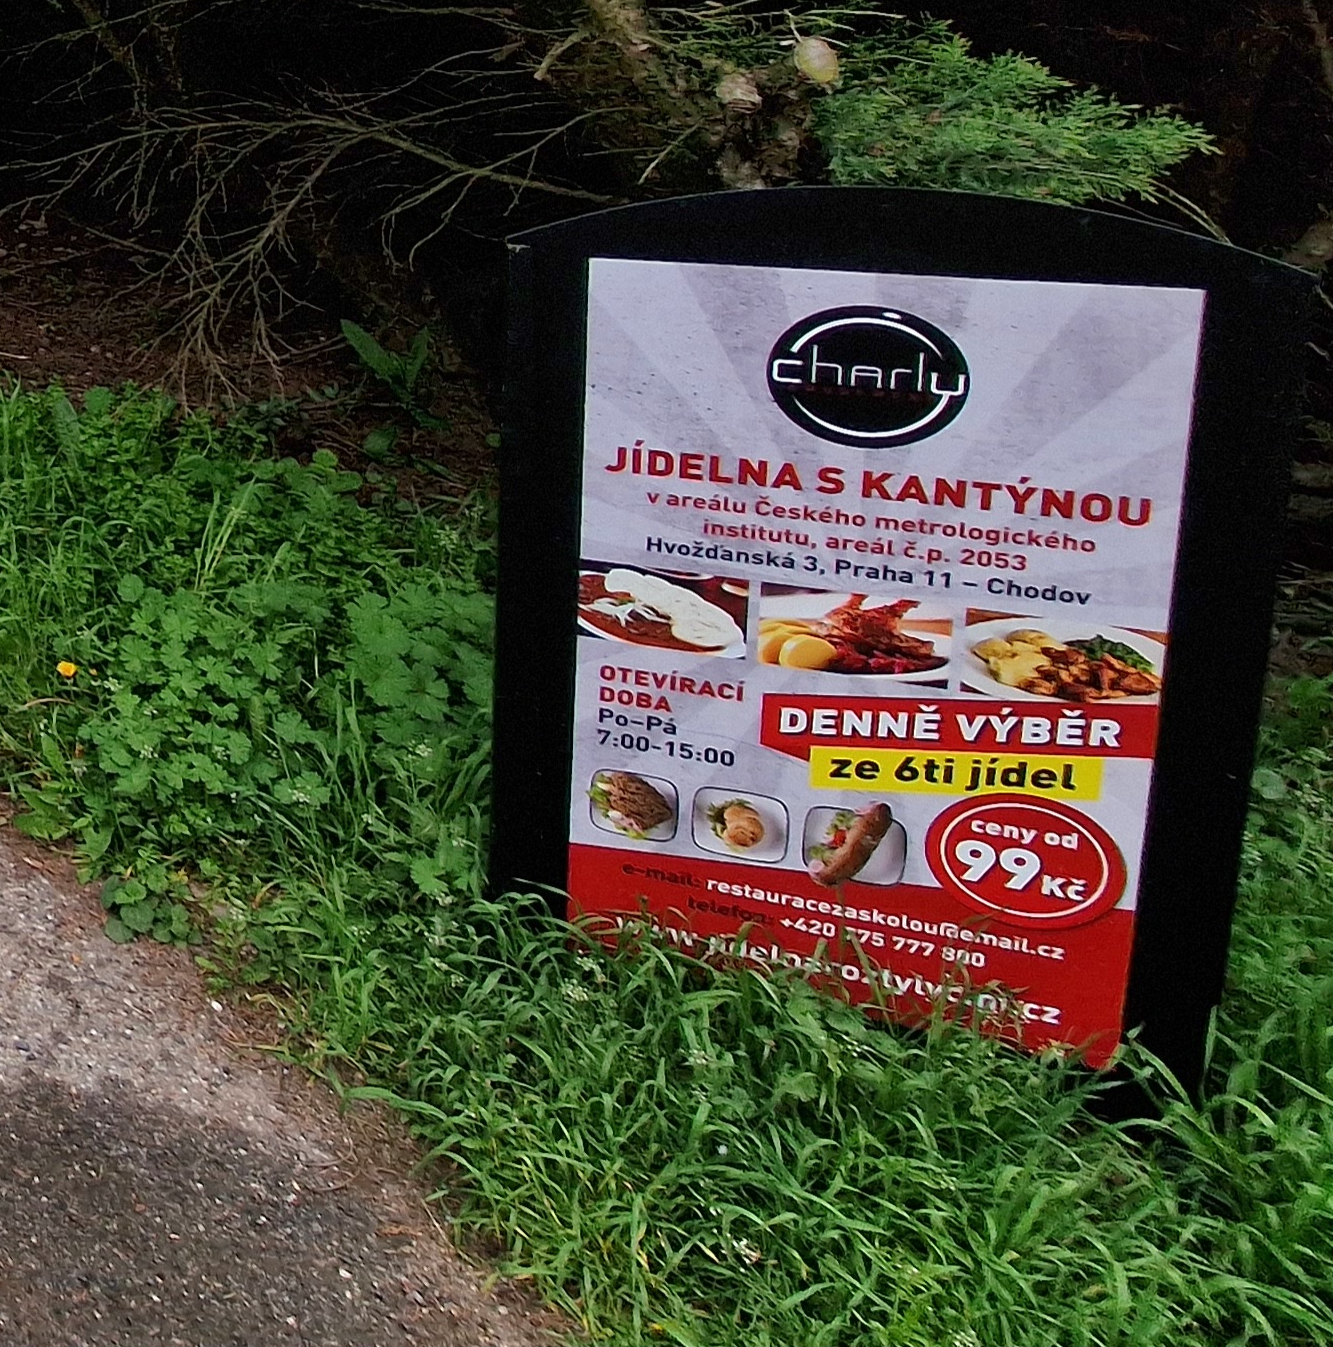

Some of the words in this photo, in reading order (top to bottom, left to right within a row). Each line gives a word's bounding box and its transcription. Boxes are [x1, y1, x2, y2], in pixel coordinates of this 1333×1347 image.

[604, 439, 802, 491] JÍDELNA
[815, 466, 845, 495] S
[861, 470, 1152, 526] KANTÝNOU
[647, 491, 659, 504] v
[666, 492, 746, 514] areálu
[755, 496, 866, 528] Českého
[875, 516, 1096, 553] metrologického
[703, 519, 817, 549] institutu,
[825, 535, 893, 556] areál
[903, 541, 950, 564] č.p.
[960, 548, 1027, 571] 2053
[646, 536, 795, 570] Hvožďanská
[803, 555, 826, 576] 3,
[835, 558, 913, 584] Praha
[923, 570, 951, 589] 11
[987, 578, 1092, 605] Chodov
[599, 686, 672, 712] DOBA
[600, 665, 745, 702] OTEVÍRACÍ
[779, 704, 941, 741] DENNĚ
[955, 707, 1121, 748] VÝBĚR
[597, 728, 735, 767] 7:00-15:00
[829, 757, 880, 780] ze
[894, 756, 954, 784] 6ti
[965, 758, 1077, 792] jídel
[970, 818, 1037, 844] ceny
[1044, 831, 1079, 850] od
[954, 839, 1041, 891] 99
[1041, 873, 1087, 902] Kč
[780, 917, 836, 938] +420
[892, 935, 935, 957] 777
